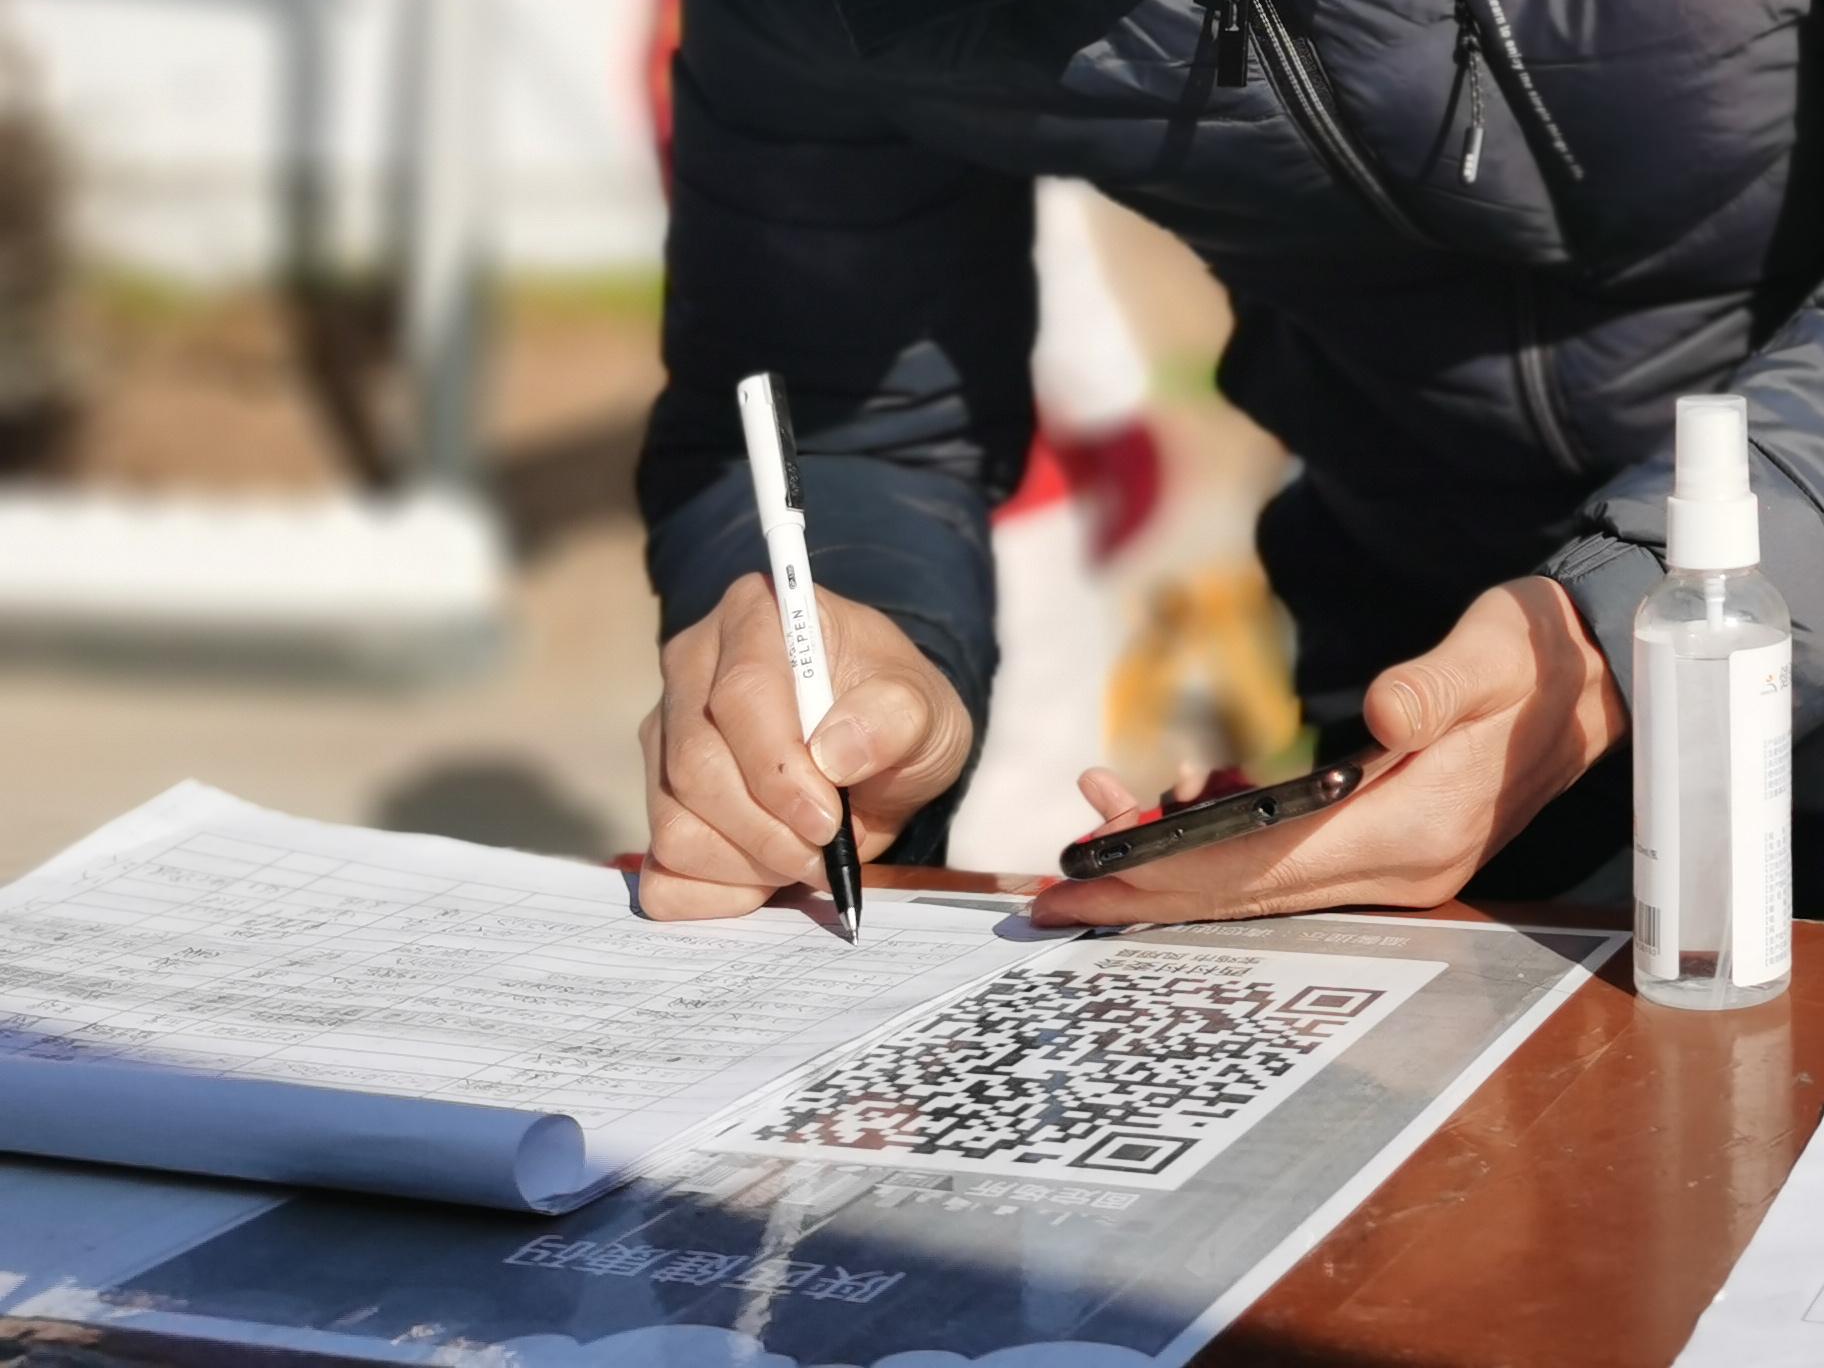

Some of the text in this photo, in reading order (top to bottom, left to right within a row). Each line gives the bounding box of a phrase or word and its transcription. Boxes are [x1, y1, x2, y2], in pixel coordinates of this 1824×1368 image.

[1504, 39, 1525, 71] enjoy
[791, 609, 815, 679] GELPEN
[964, 1180, 1141, 1209] 固定场所
[502, 1234, 906, 1304] 陕西健康码
